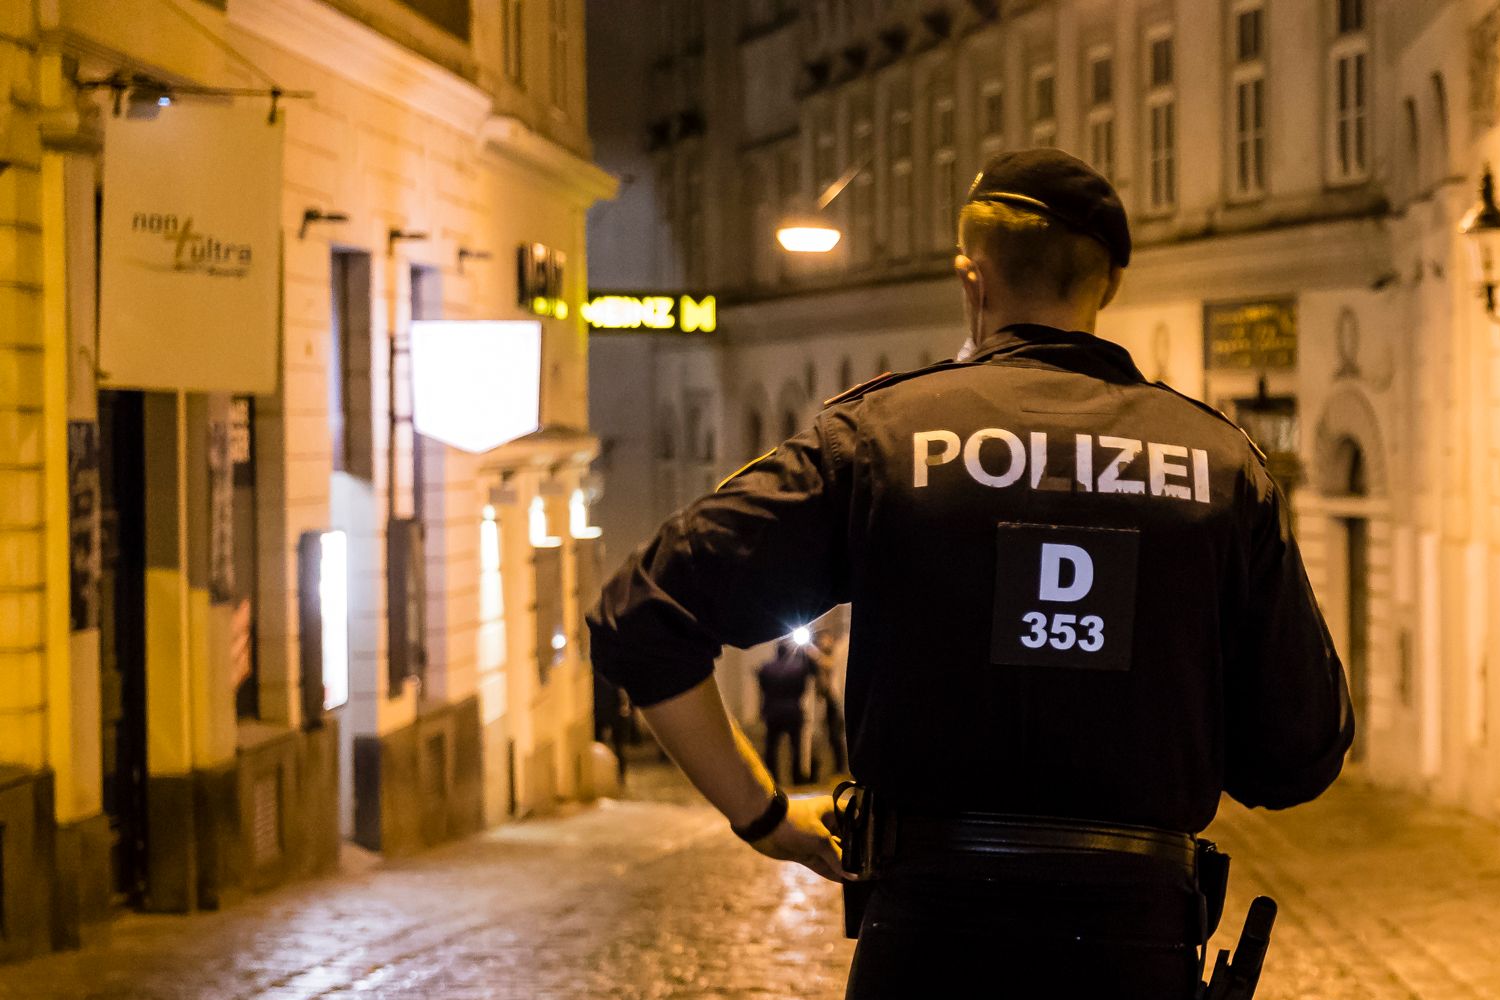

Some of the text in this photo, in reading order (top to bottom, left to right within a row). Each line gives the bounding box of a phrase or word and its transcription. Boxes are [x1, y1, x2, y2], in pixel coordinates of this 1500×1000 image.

[132, 212, 178, 233] non
[913, 428, 1210, 503] POLIZEI
[1039, 543, 1094, 602] D
[1020, 611, 1105, 652] 353
